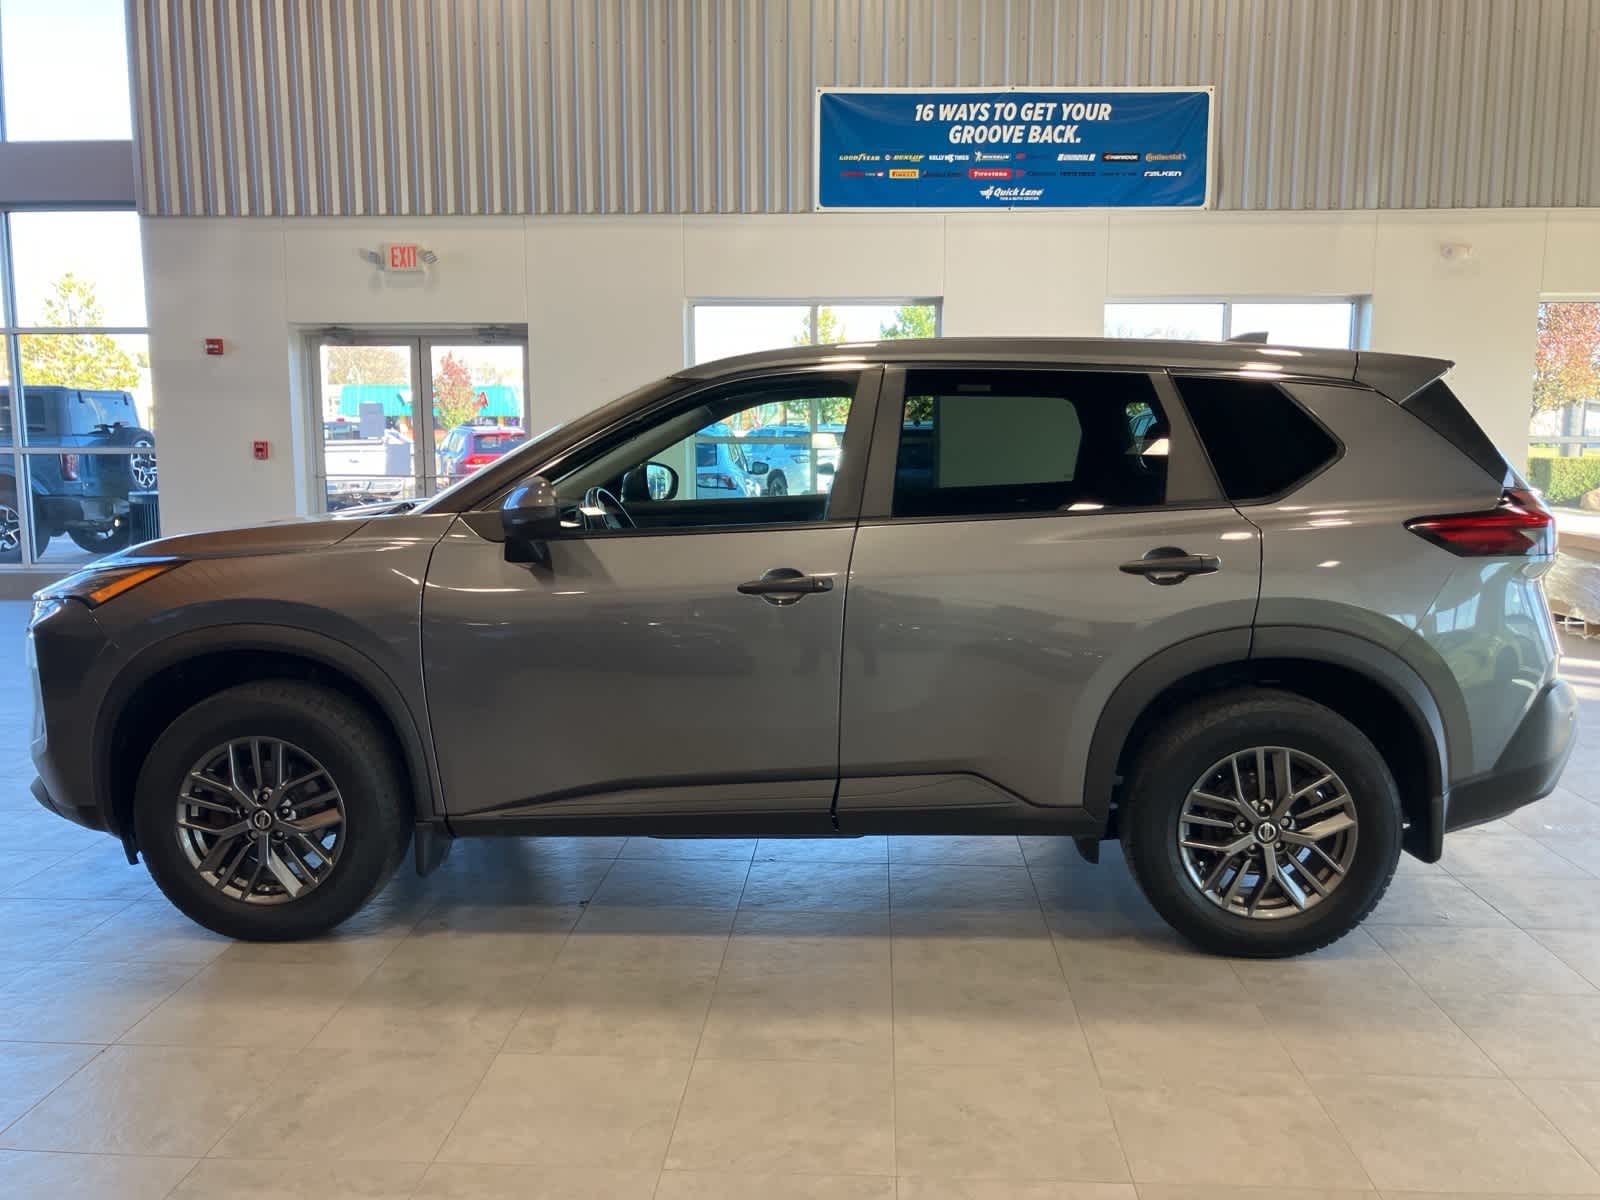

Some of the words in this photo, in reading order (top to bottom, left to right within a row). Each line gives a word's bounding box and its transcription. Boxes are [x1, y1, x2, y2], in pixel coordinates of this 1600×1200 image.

[915, 103, 935, 121] 16
[938, 103, 990, 121] WAYS
[993, 102, 1017, 121] TO
[1020, 102, 1057, 121] GET
[1061, 103, 1112, 121] YOUR
[948, 125, 1026, 144] GROOVE
[1027, 125, 1081, 144] BACK.
[838, 152, 880, 162] GOODYEAR
[993, 187, 1019, 197] Quick
[1020, 187, 1045, 197] Lane
[391, 245, 417, 268] EXIT
